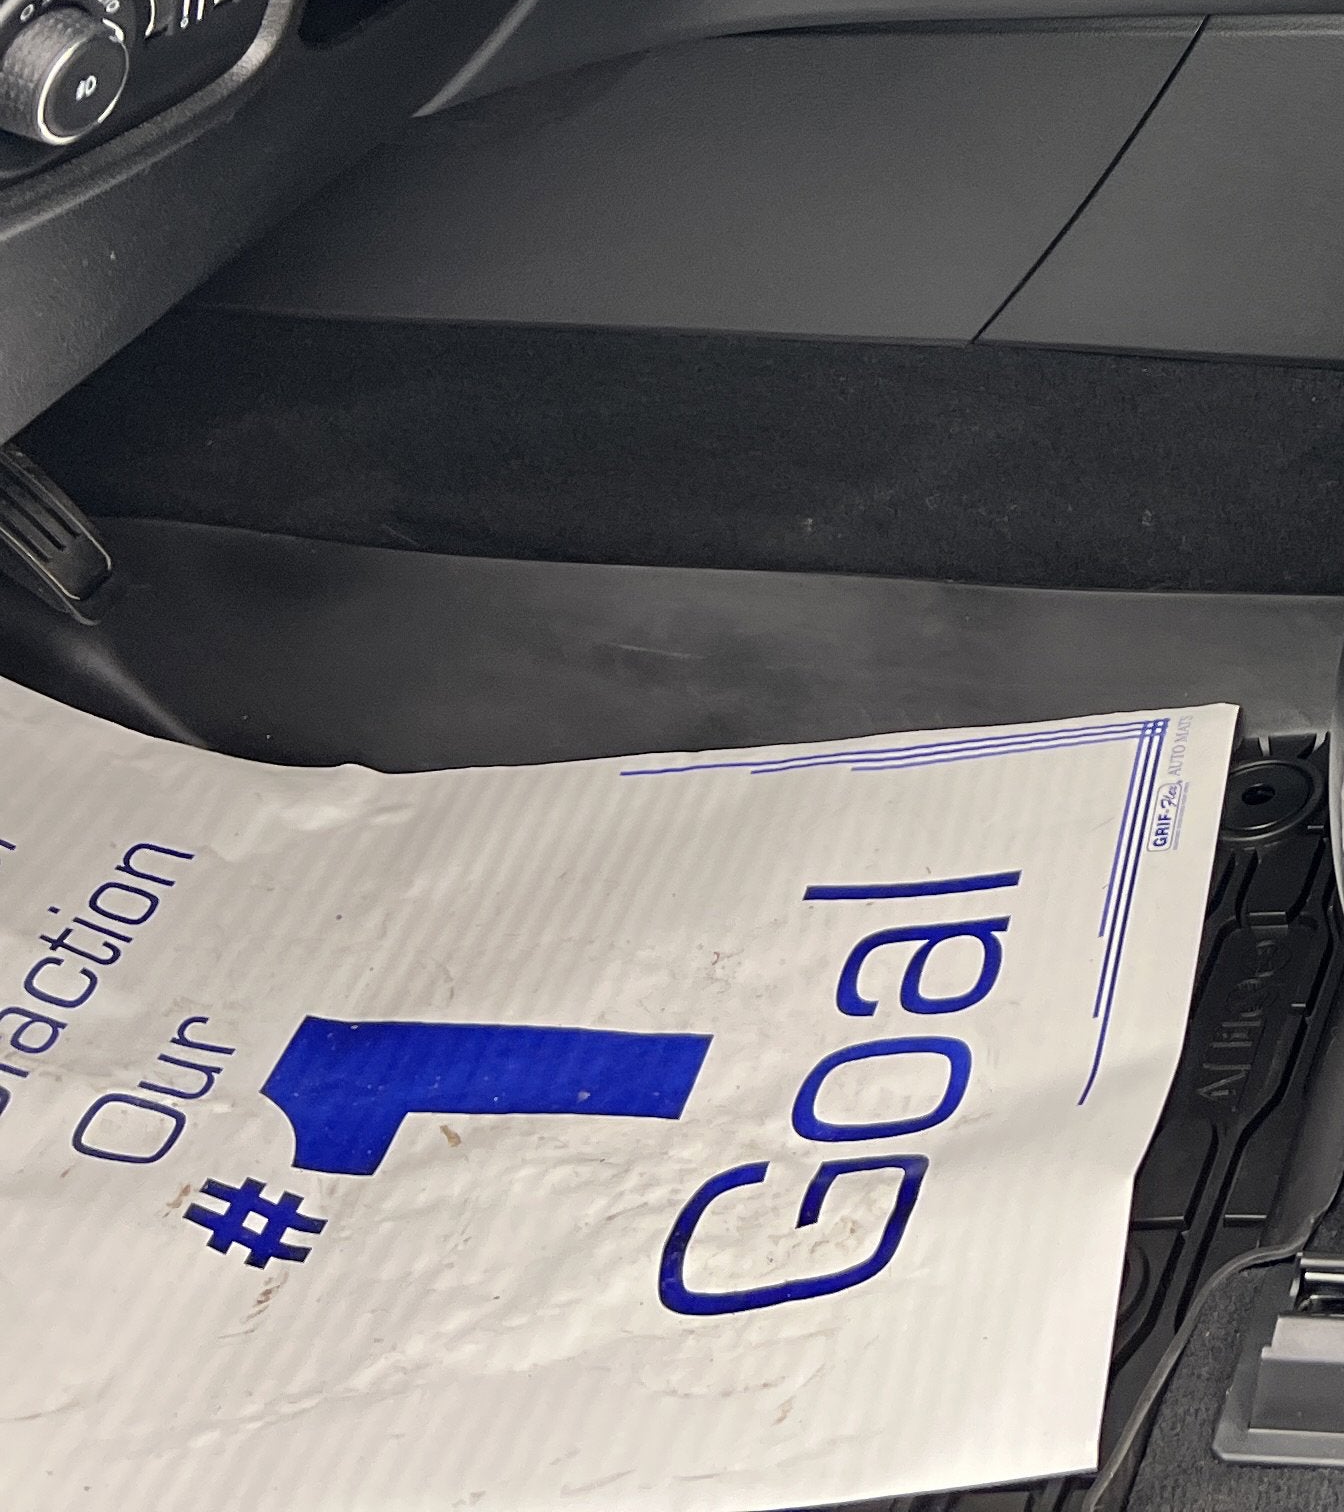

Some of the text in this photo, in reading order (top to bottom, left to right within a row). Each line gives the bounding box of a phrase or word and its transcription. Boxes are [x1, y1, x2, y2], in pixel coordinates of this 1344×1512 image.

[1168, 744, 1186, 776] AUTO
[0, 841, 196, 1117] action
[72, 1016, 236, 1165] Our
[658, 869, 1022, 1316] Goal
